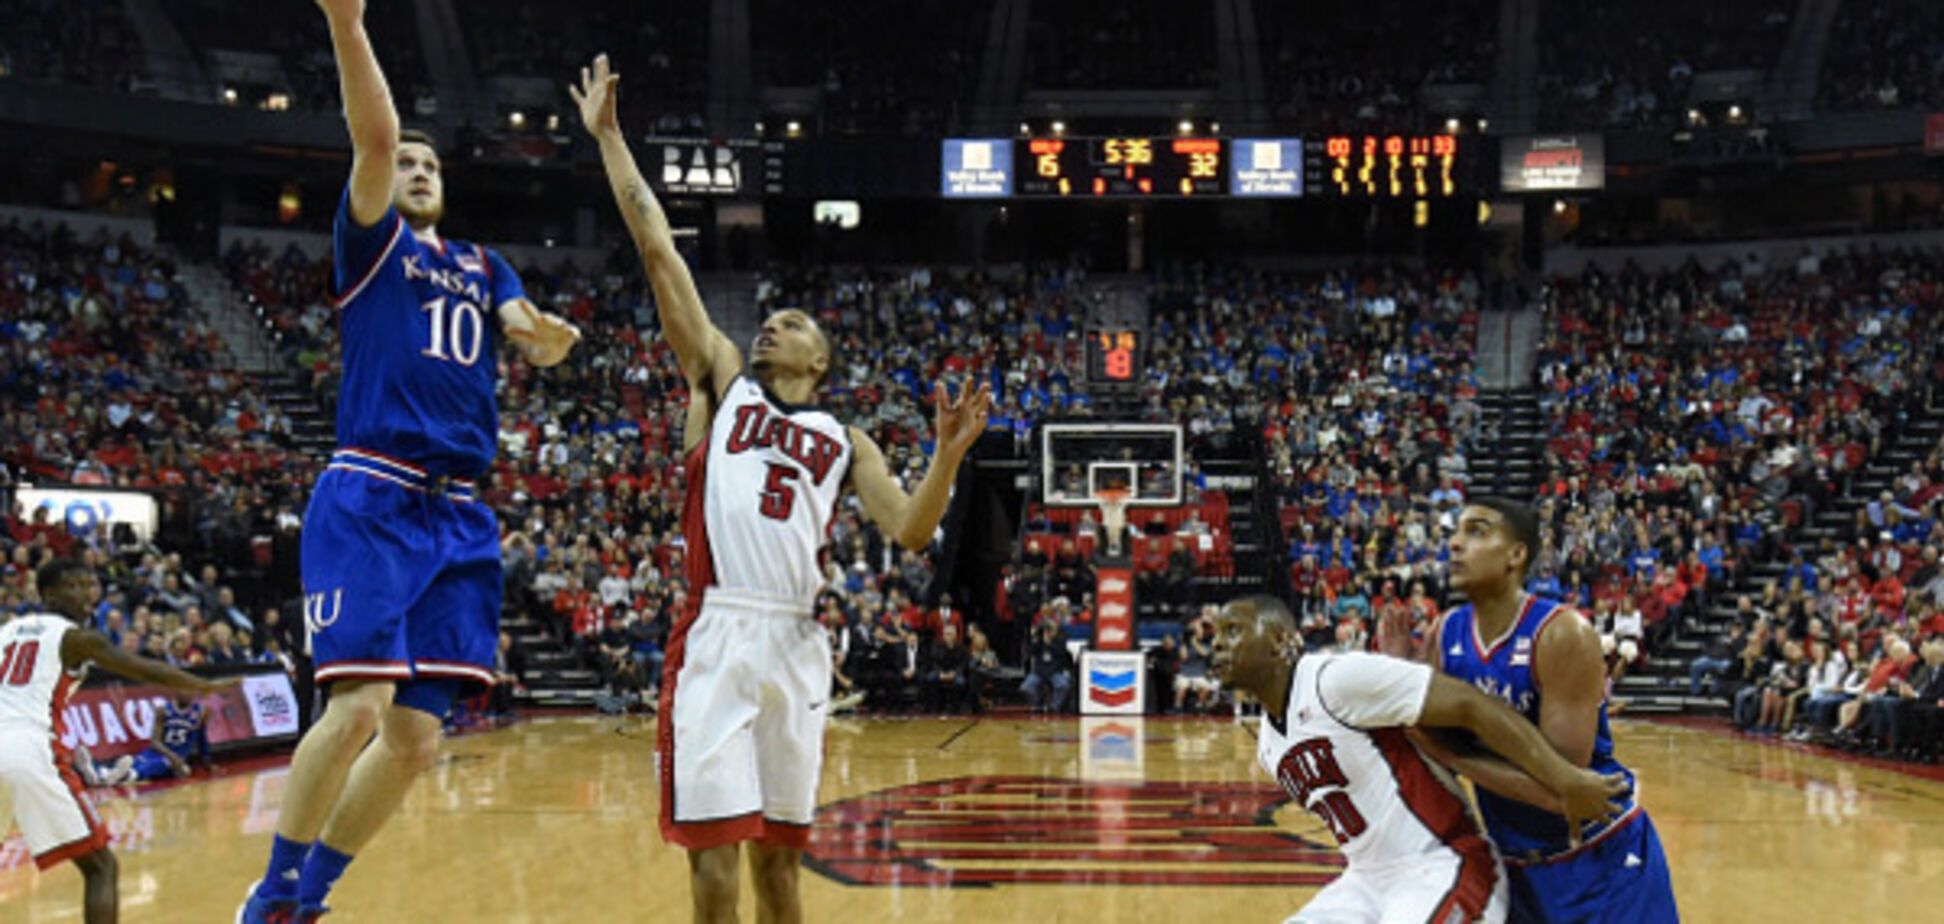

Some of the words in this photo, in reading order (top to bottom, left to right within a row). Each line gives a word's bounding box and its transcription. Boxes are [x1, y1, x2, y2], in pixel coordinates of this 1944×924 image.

[1105, 139, 1151, 164] 5:36
[1190, 153, 1217, 177] 32
[1364, 138, 1376, 155] 2
[1411, 138, 1430, 153] 11
[421, 297, 482, 366] 10
[727, 402, 843, 486] UNLV
[759, 460, 801, 521] 5
[0, 640, 40, 686] 10
